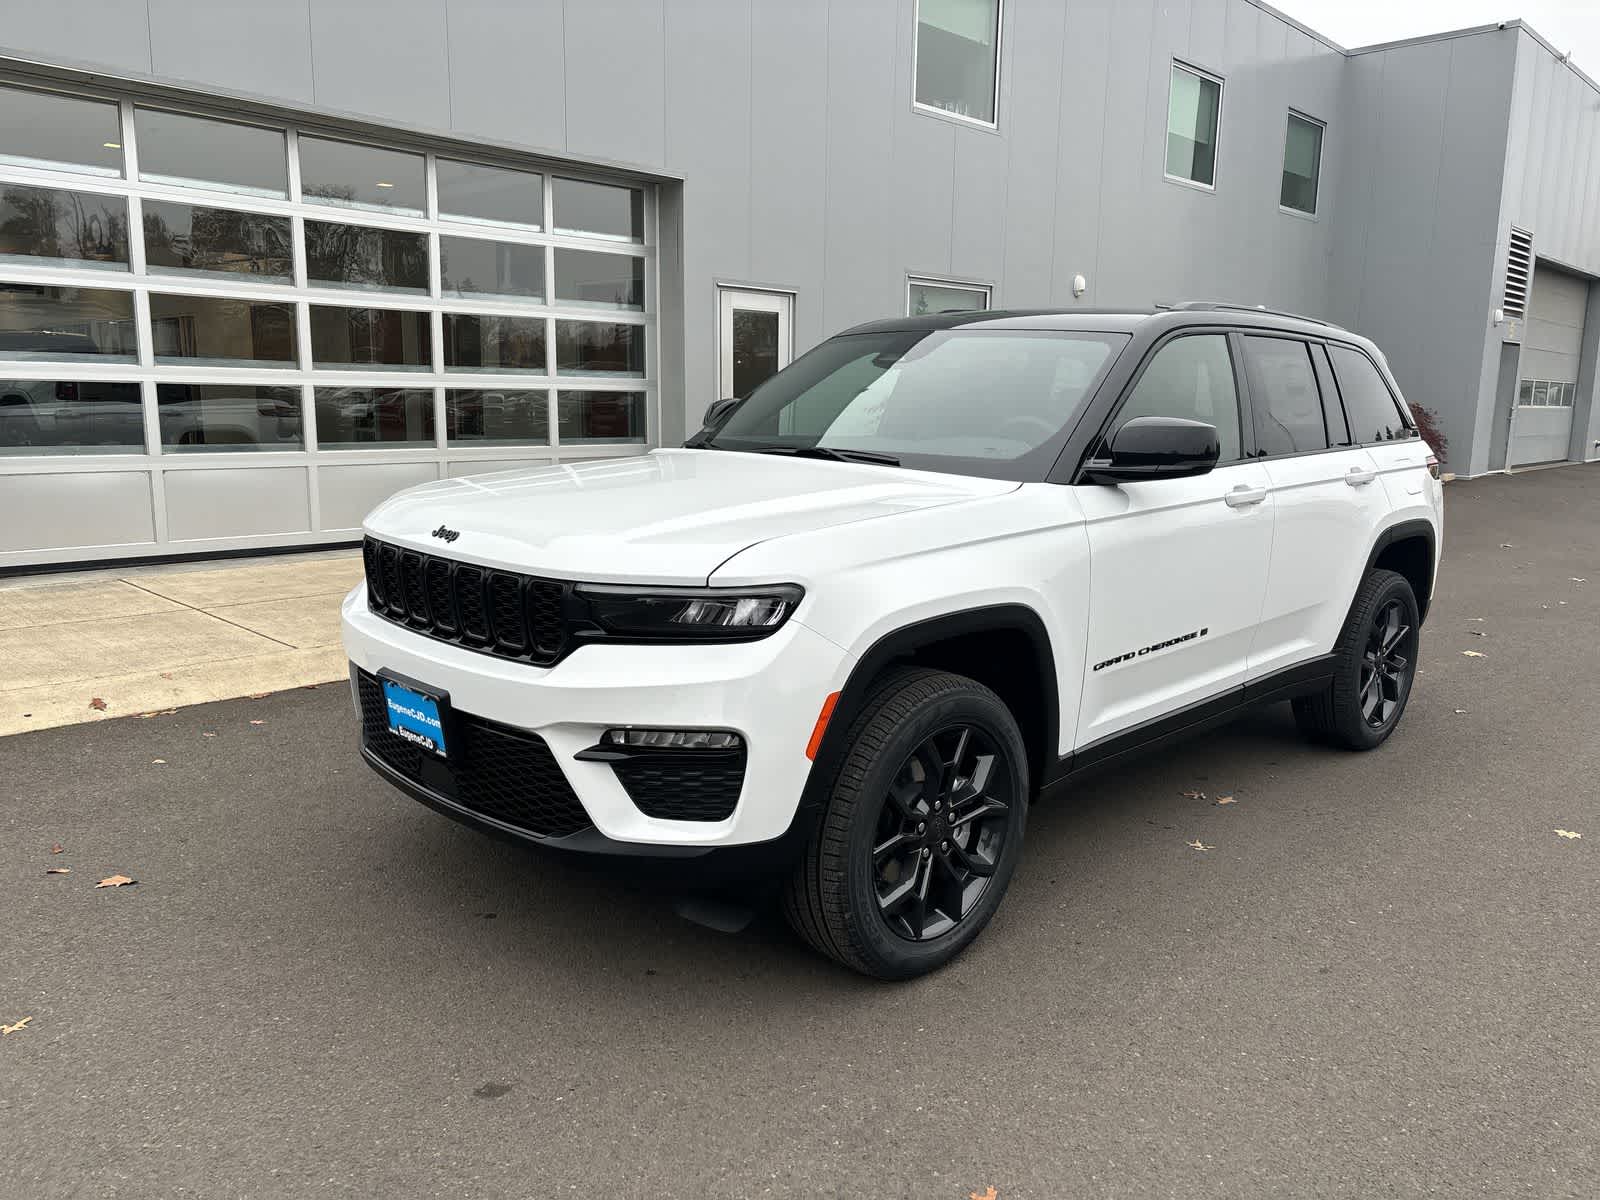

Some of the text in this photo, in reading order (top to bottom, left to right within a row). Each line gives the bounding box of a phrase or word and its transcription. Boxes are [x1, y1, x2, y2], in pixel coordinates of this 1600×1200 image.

[432, 525, 460, 543] Jeep
[1093, 632, 1198, 671] GRAND CHEROKEE
[387, 698, 441, 728] EugeneCJD.com
[399, 725, 434, 749] EugeneCJD
